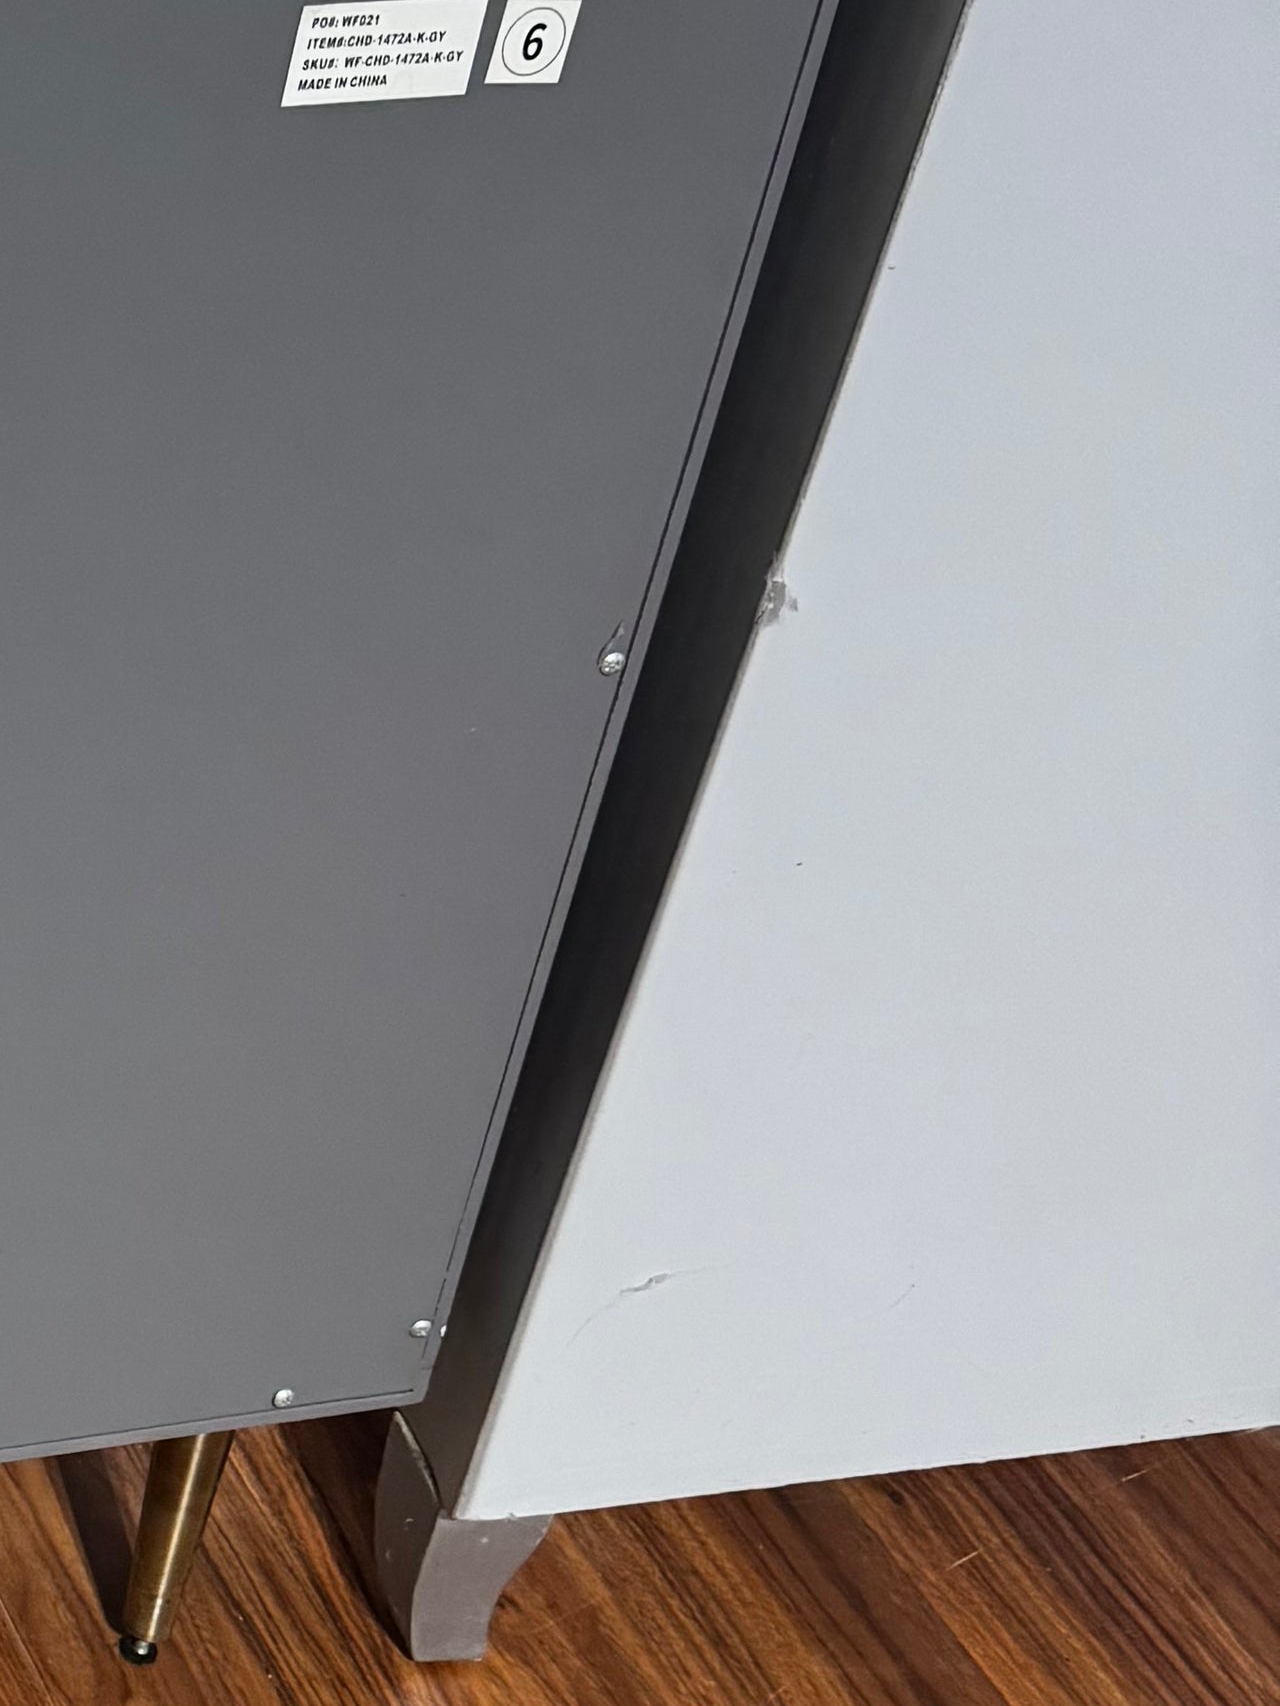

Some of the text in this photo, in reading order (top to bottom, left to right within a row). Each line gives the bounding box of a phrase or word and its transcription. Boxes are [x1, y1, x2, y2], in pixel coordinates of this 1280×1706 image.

[342, 14, 380, 28] WF021
[522, 22, 548, 61] 6
[298, 74, 387, 92] MADE IN CHINA
